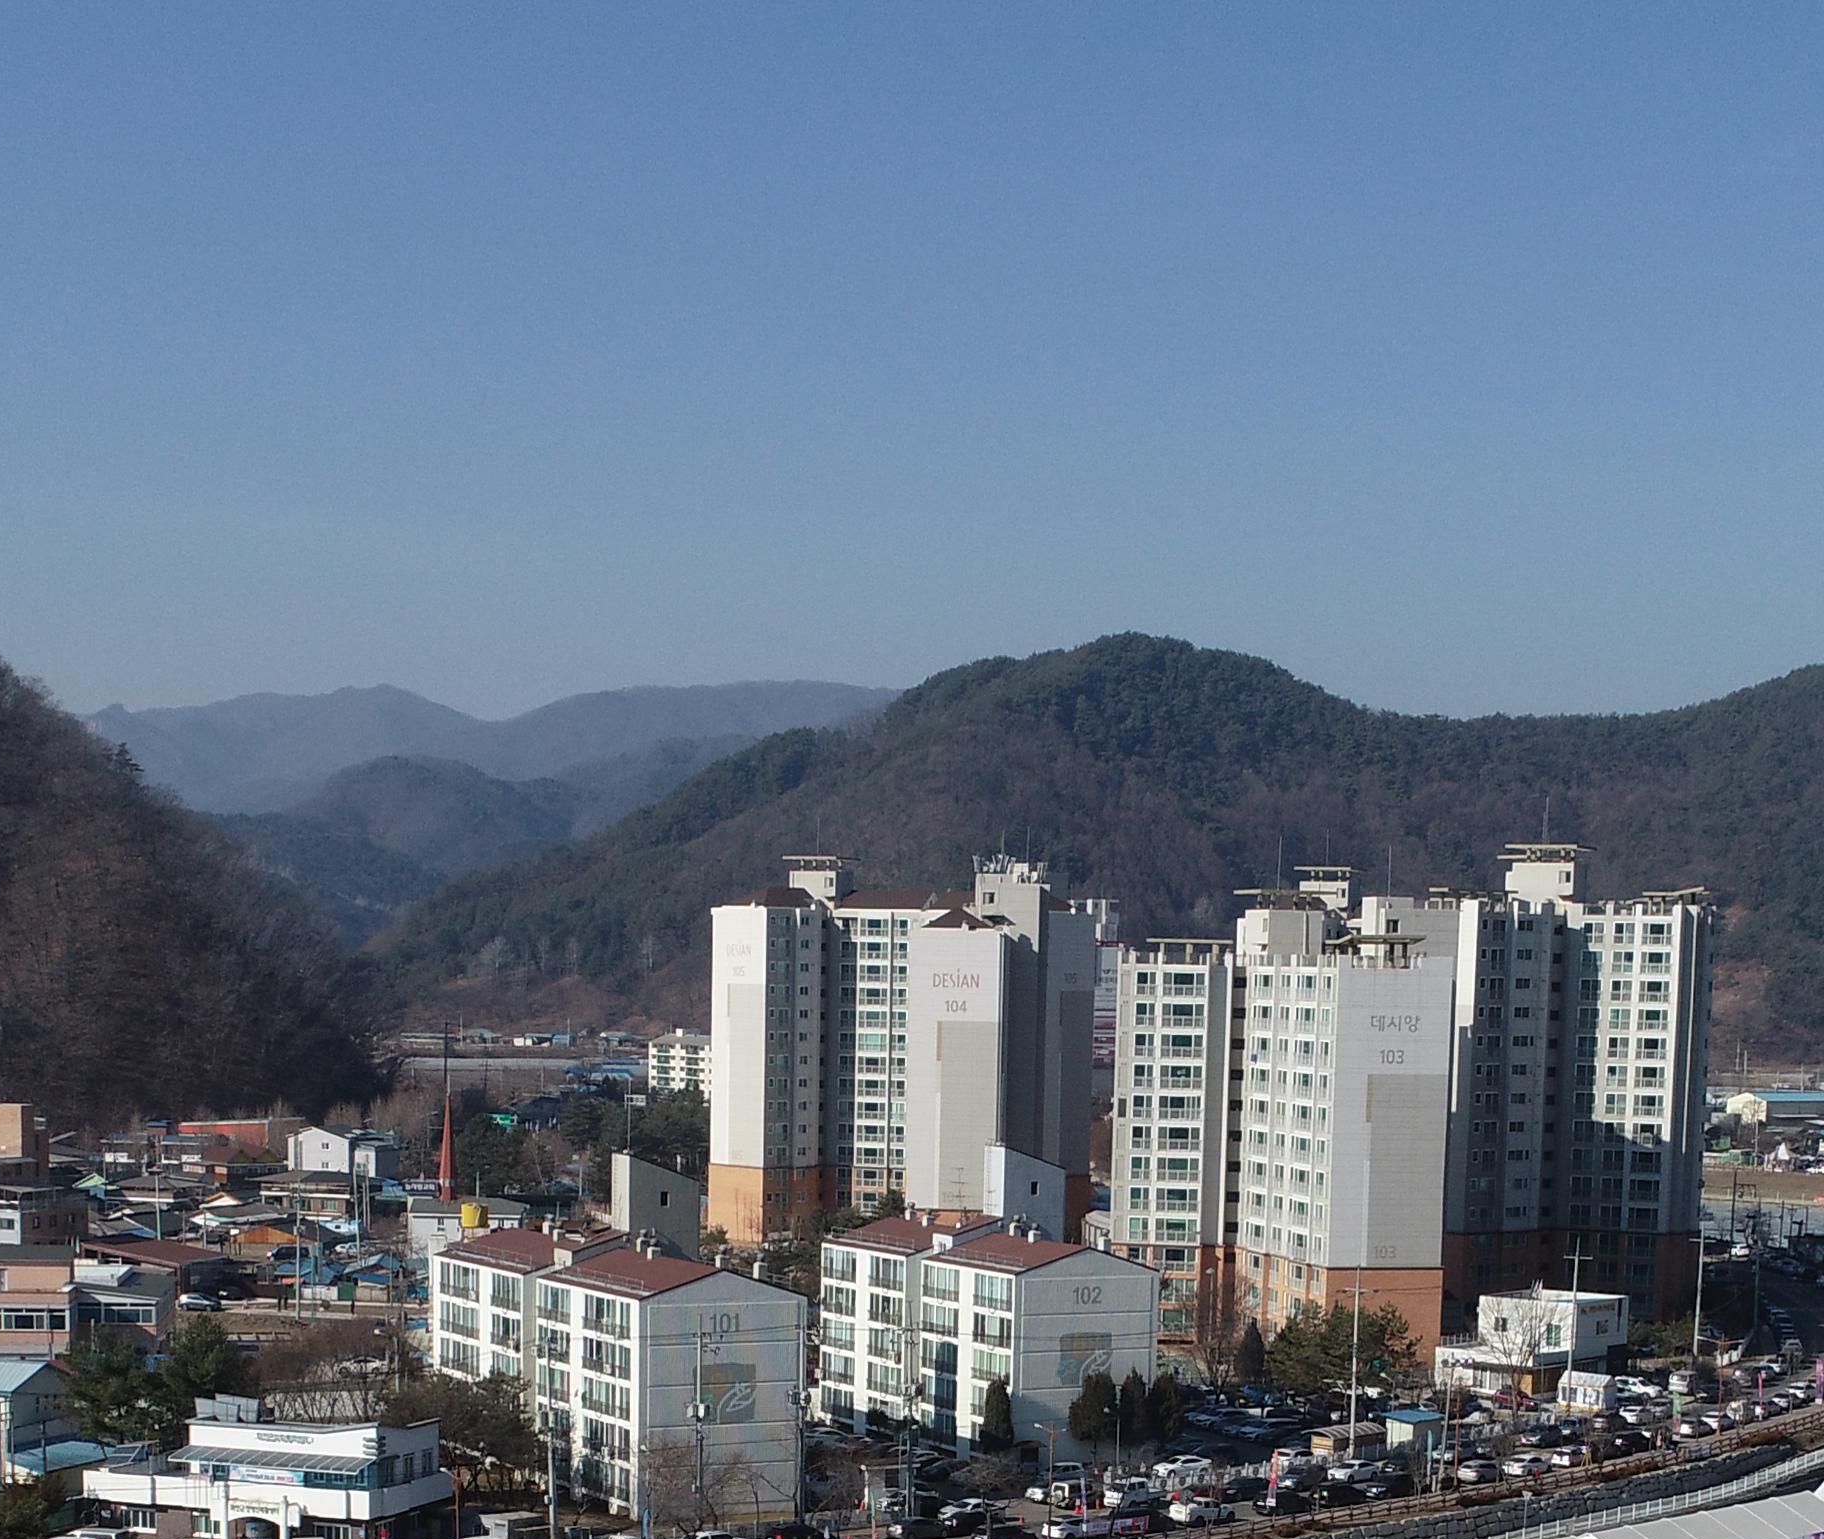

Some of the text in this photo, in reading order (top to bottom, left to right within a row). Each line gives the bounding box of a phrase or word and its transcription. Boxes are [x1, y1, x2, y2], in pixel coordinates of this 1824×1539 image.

[945, 1000, 967, 1013] 104
[1370, 1014, 1421, 1033] 데시앙
[1380, 1050, 1405, 1065] 103
[1072, 1287, 1102, 1305] 102
[709, 1313, 740, 1333] 101
